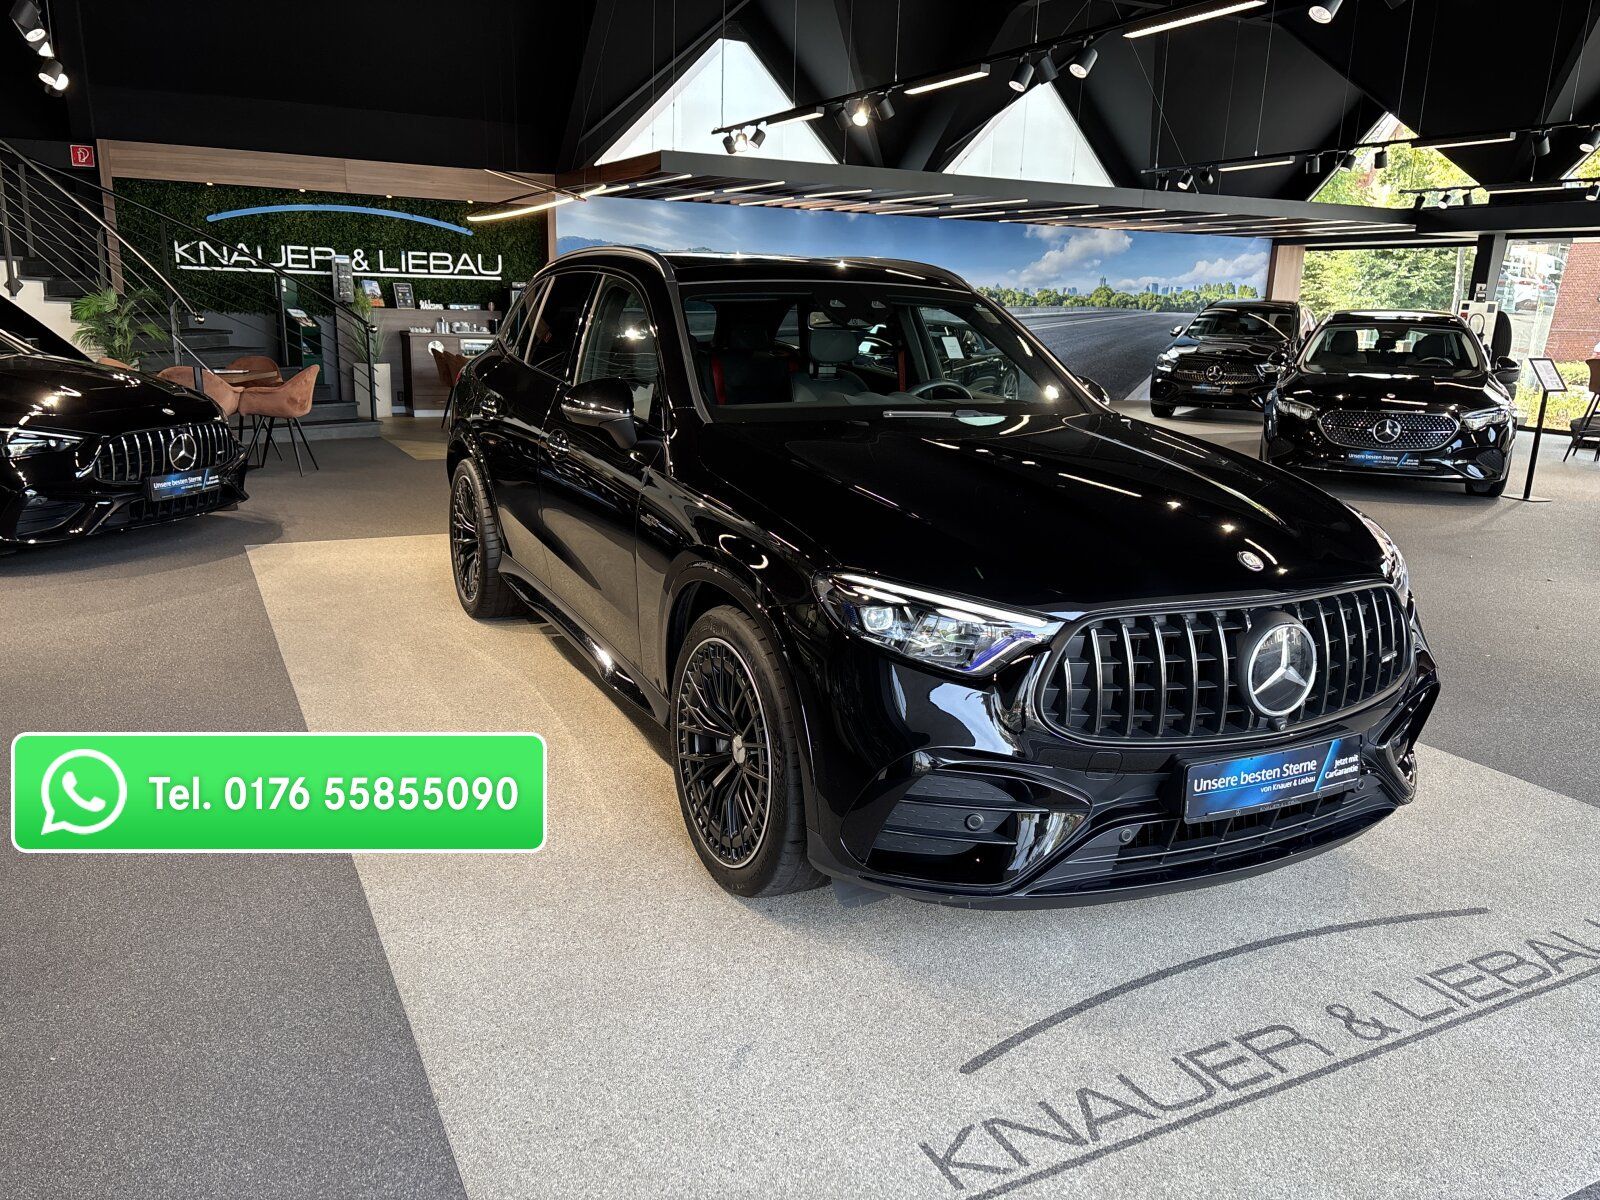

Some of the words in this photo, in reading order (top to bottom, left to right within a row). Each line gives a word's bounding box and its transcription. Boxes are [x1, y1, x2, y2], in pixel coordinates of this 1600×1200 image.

[174, 240, 336, 269] KNAUER
[351, 248, 370, 272] &
[379, 249, 502, 275] LIEBAU
[171, 478, 188, 486] besten
[1333, 757, 1348, 769] Jetzt
[1348, 754, 1359, 763] mit
[1193, 775, 1239, 792] Unsere
[1240, 767, 1280, 785] besten
[1282, 759, 1317, 777] Sterne
[1324, 764, 1359, 779] CarGarantie
[1260, 785, 1272, 793] von
[1272, 780, 1292, 791] Knauer
[1292, 778, 1298, 787] &
[1298, 775, 1315, 785] Liebau
[918, 1022, 1336, 1191] KNAUER
[1324, 1002, 1401, 1041] &
